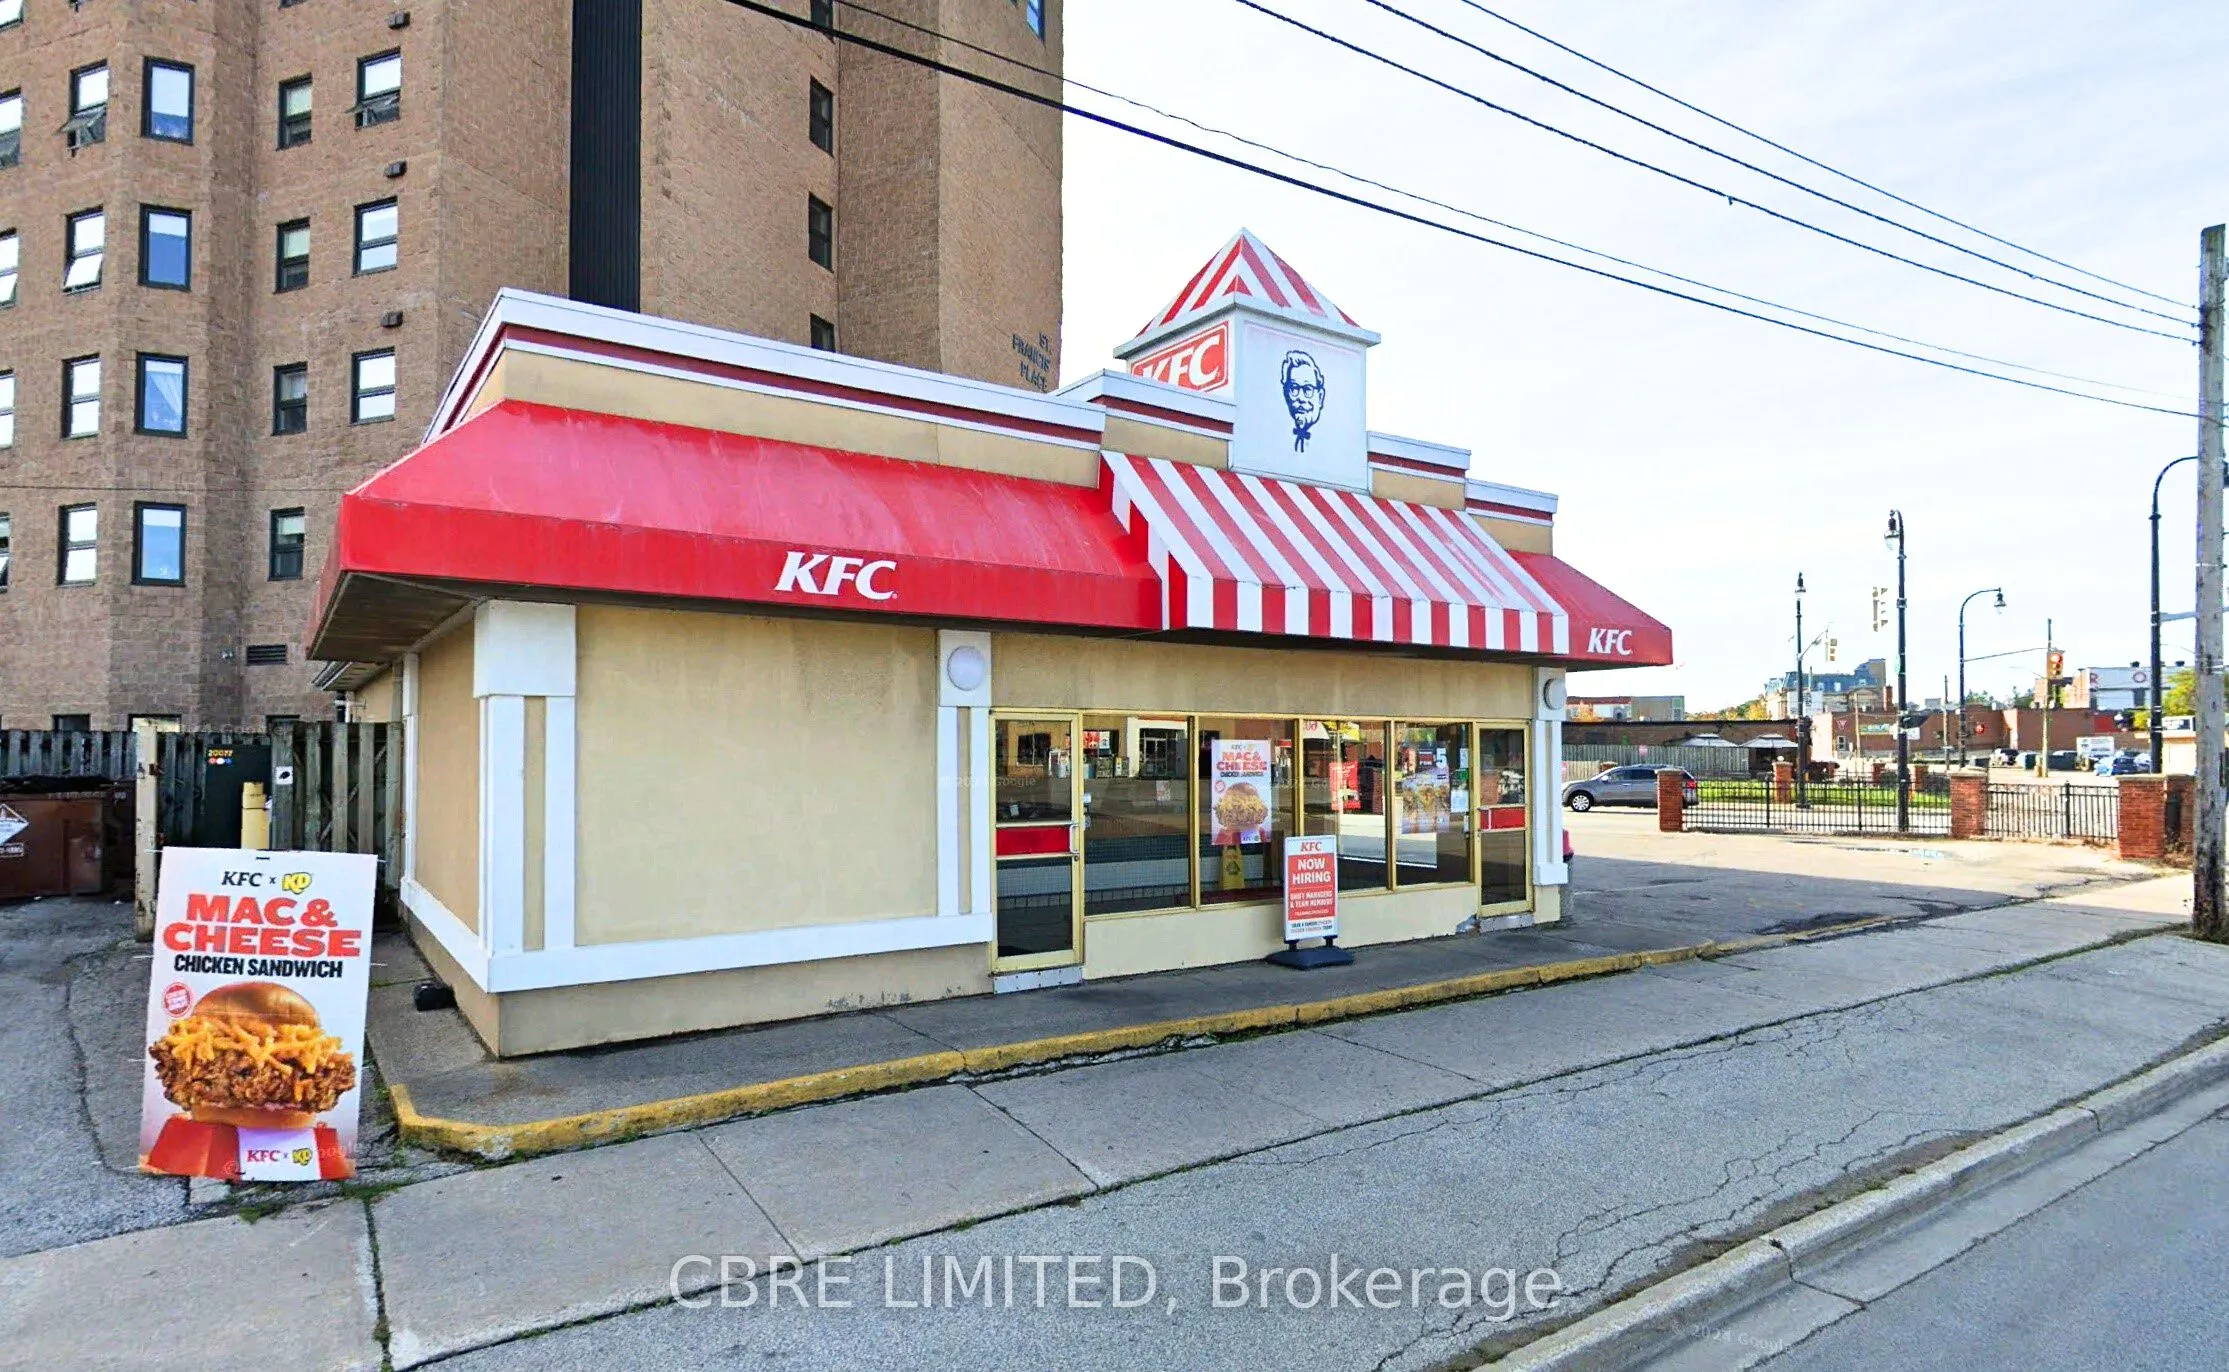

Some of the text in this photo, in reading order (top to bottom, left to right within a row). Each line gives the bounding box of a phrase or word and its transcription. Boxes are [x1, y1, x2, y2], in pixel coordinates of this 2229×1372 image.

[1012, 333, 1051, 373] FRANCIS
[774, 550, 898, 601] KFC
[1586, 627, 1634, 656] KFC
[1300, 841, 1322, 852] KFC
[1297, 858, 1326, 871] NOW
[221, 871, 263, 887] KFC
[281, 872, 312, 895] KD
[1292, 871, 1331, 885] HIRING
[187, 893, 338, 928] MAC &
[162, 922, 362, 959] CHEESE
[174, 954, 343, 978] CHICKEN SANDWICH
[247, 1149, 281, 1162] KFC
